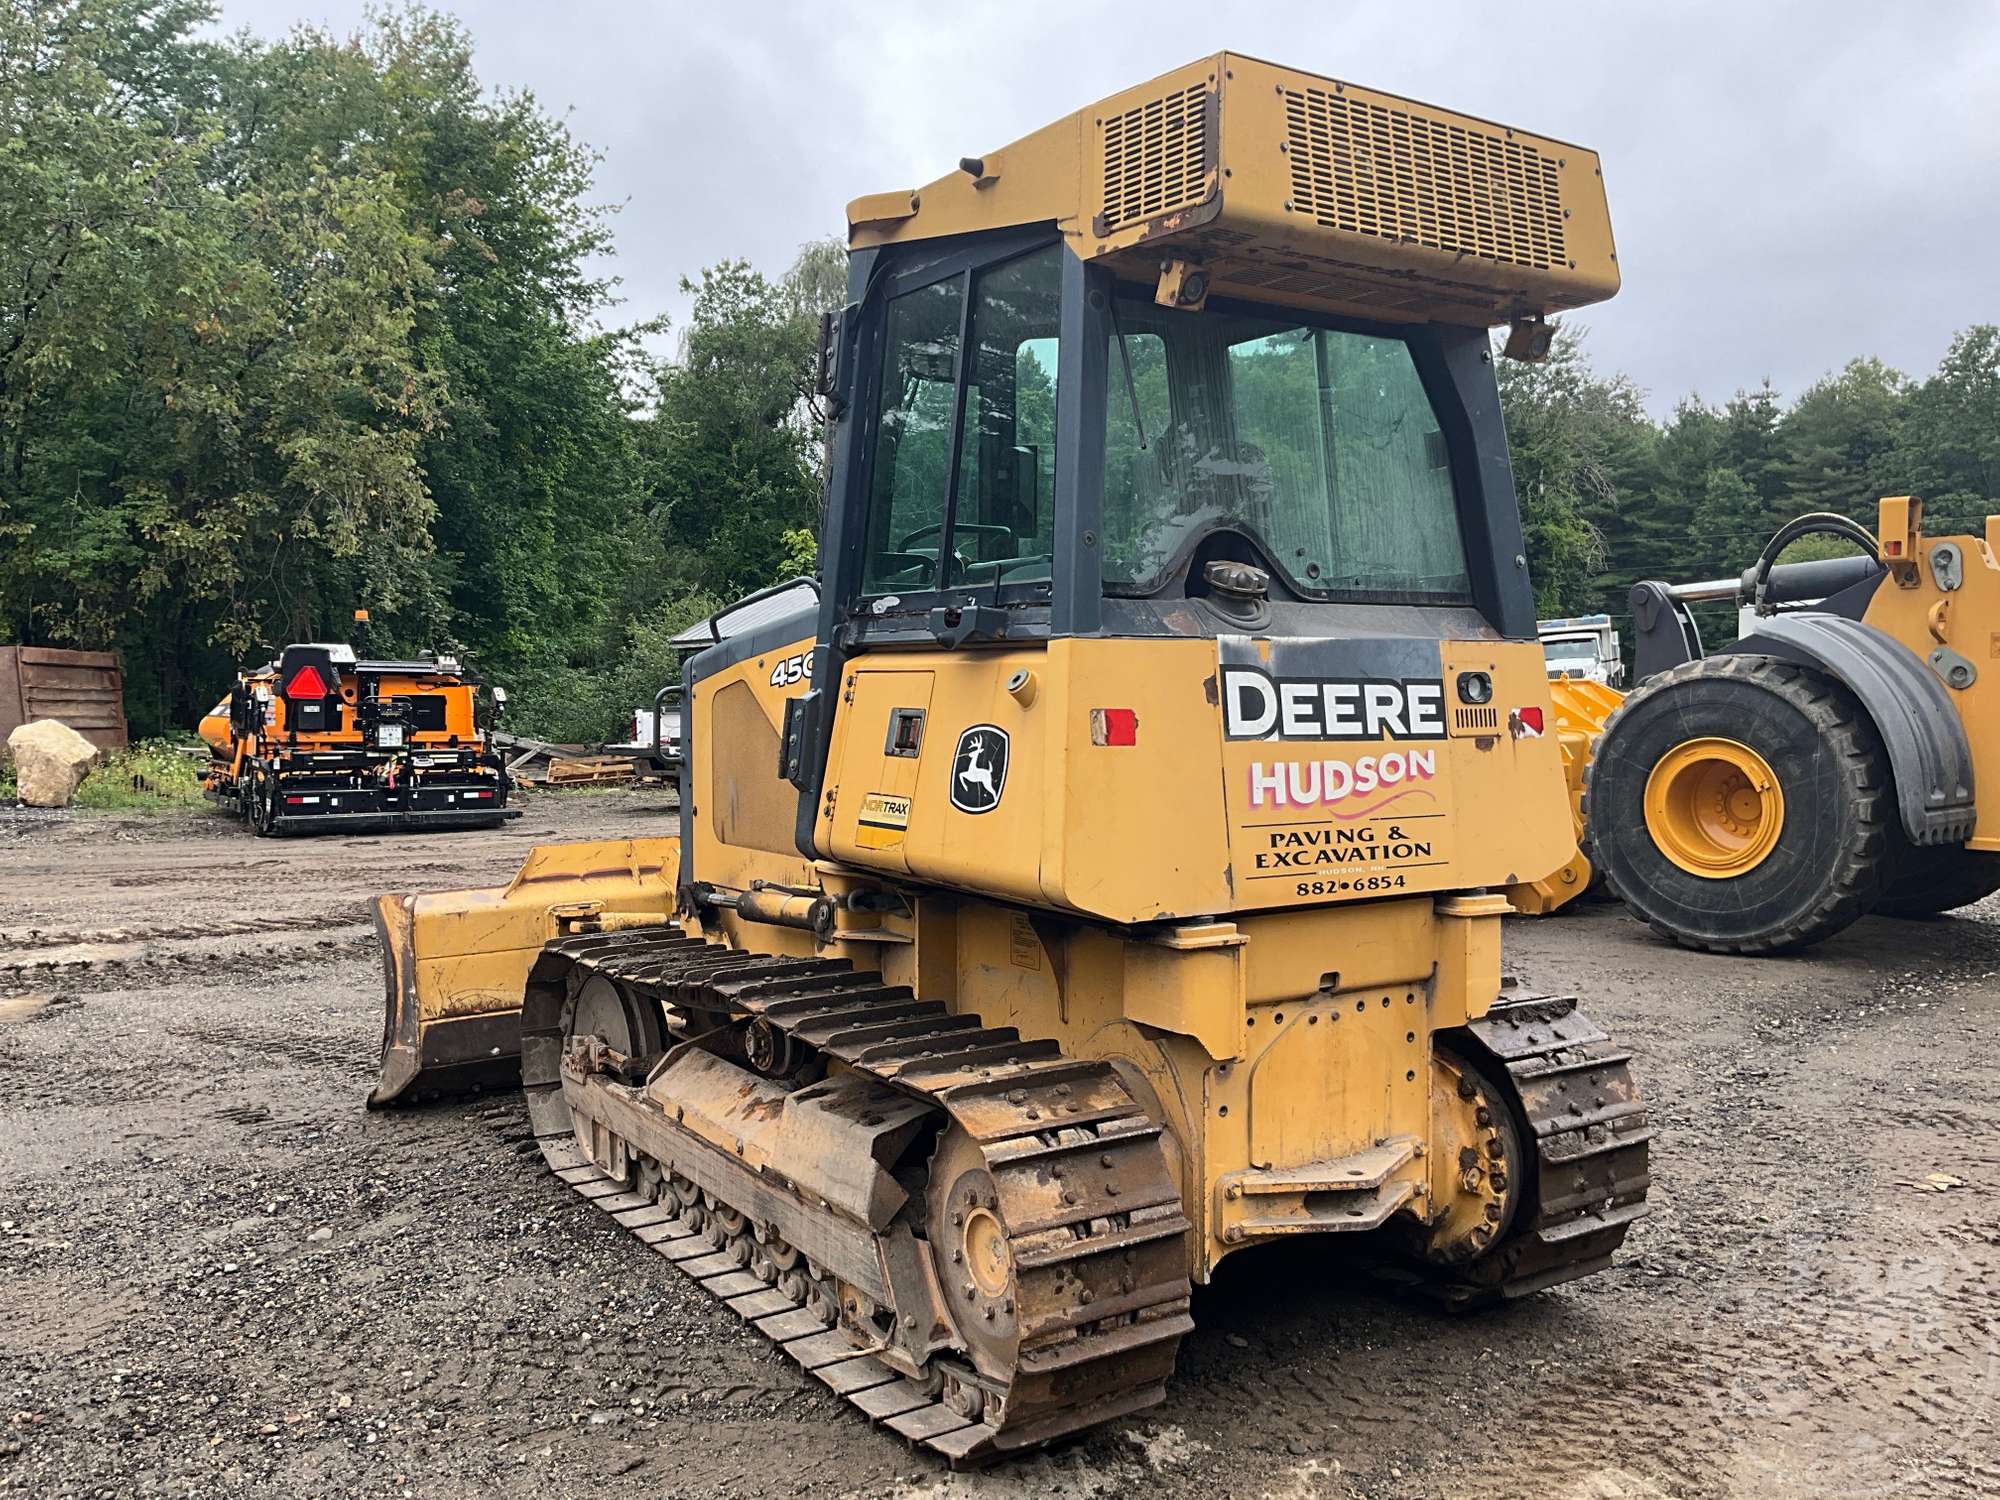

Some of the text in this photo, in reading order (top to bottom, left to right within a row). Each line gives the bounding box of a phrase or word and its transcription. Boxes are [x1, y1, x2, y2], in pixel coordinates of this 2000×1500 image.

[1225, 671, 1444, 736] DEERE
[1249, 750, 1436, 809] HUDSON
[861, 799, 908, 815] NORTRAX
[1270, 826, 1411, 849] PAVING &
[1255, 842, 1431, 869] EXCAVATION
